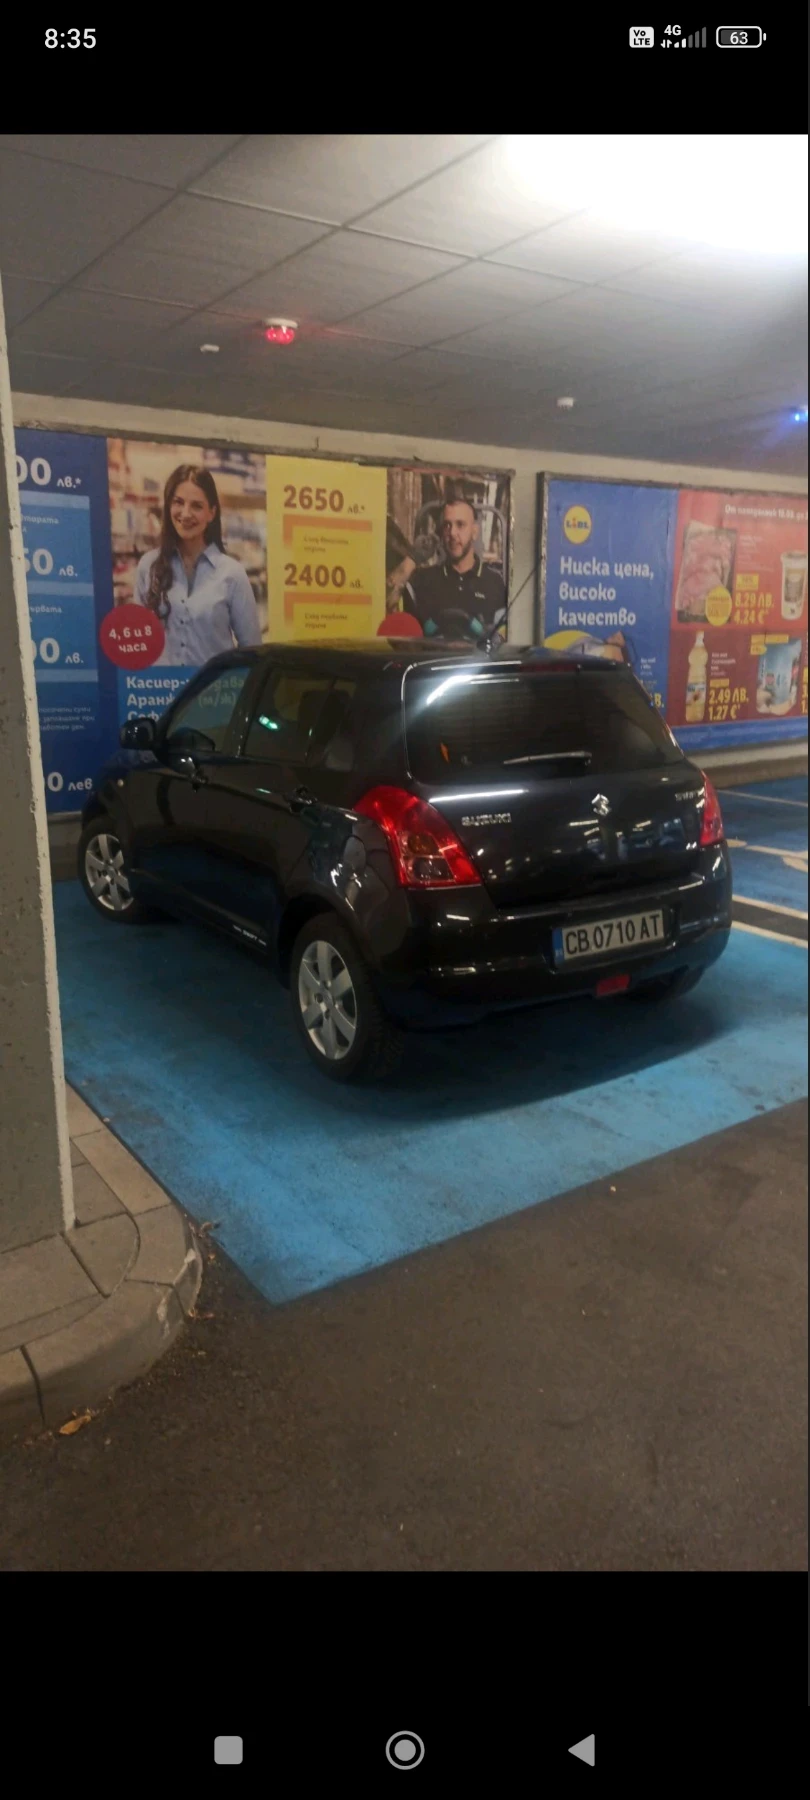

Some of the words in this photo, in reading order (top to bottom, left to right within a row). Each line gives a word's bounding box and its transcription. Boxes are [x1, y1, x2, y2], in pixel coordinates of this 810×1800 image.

[284, 484, 344, 512] 2650
[59, 565, 78, 577] лв.
[284, 562, 346, 588] 2400
[560, 555, 610, 576] Ниска
[614, 562, 654, 580] цена,
[559, 581, 616, 601] високо
[735, 592, 756, 608] 8.29
[758, 593, 775, 608] ЛВ.
[558, 607, 637, 626] качество
[733, 609, 756, 625] 4.24
[109, 628, 121, 640] 4,
[123, 627, 131, 639] 6
[134, 627, 142, 637] и
[144, 625, 152, 637] 8
[118, 642, 147, 653] часа
[65, 652, 84, 665] лв.
[709, 688, 731, 705] 2.49
[732, 686, 749, 704] ЛВ.
[709, 705, 729, 722] 1.27
[68, 778, 93, 791] лев
[461, 812, 511, 826] SUZUKI
[565, 928, 590, 955] CB
[593, 919, 636, 949] 0710
[640, 914, 660, 941] AT
